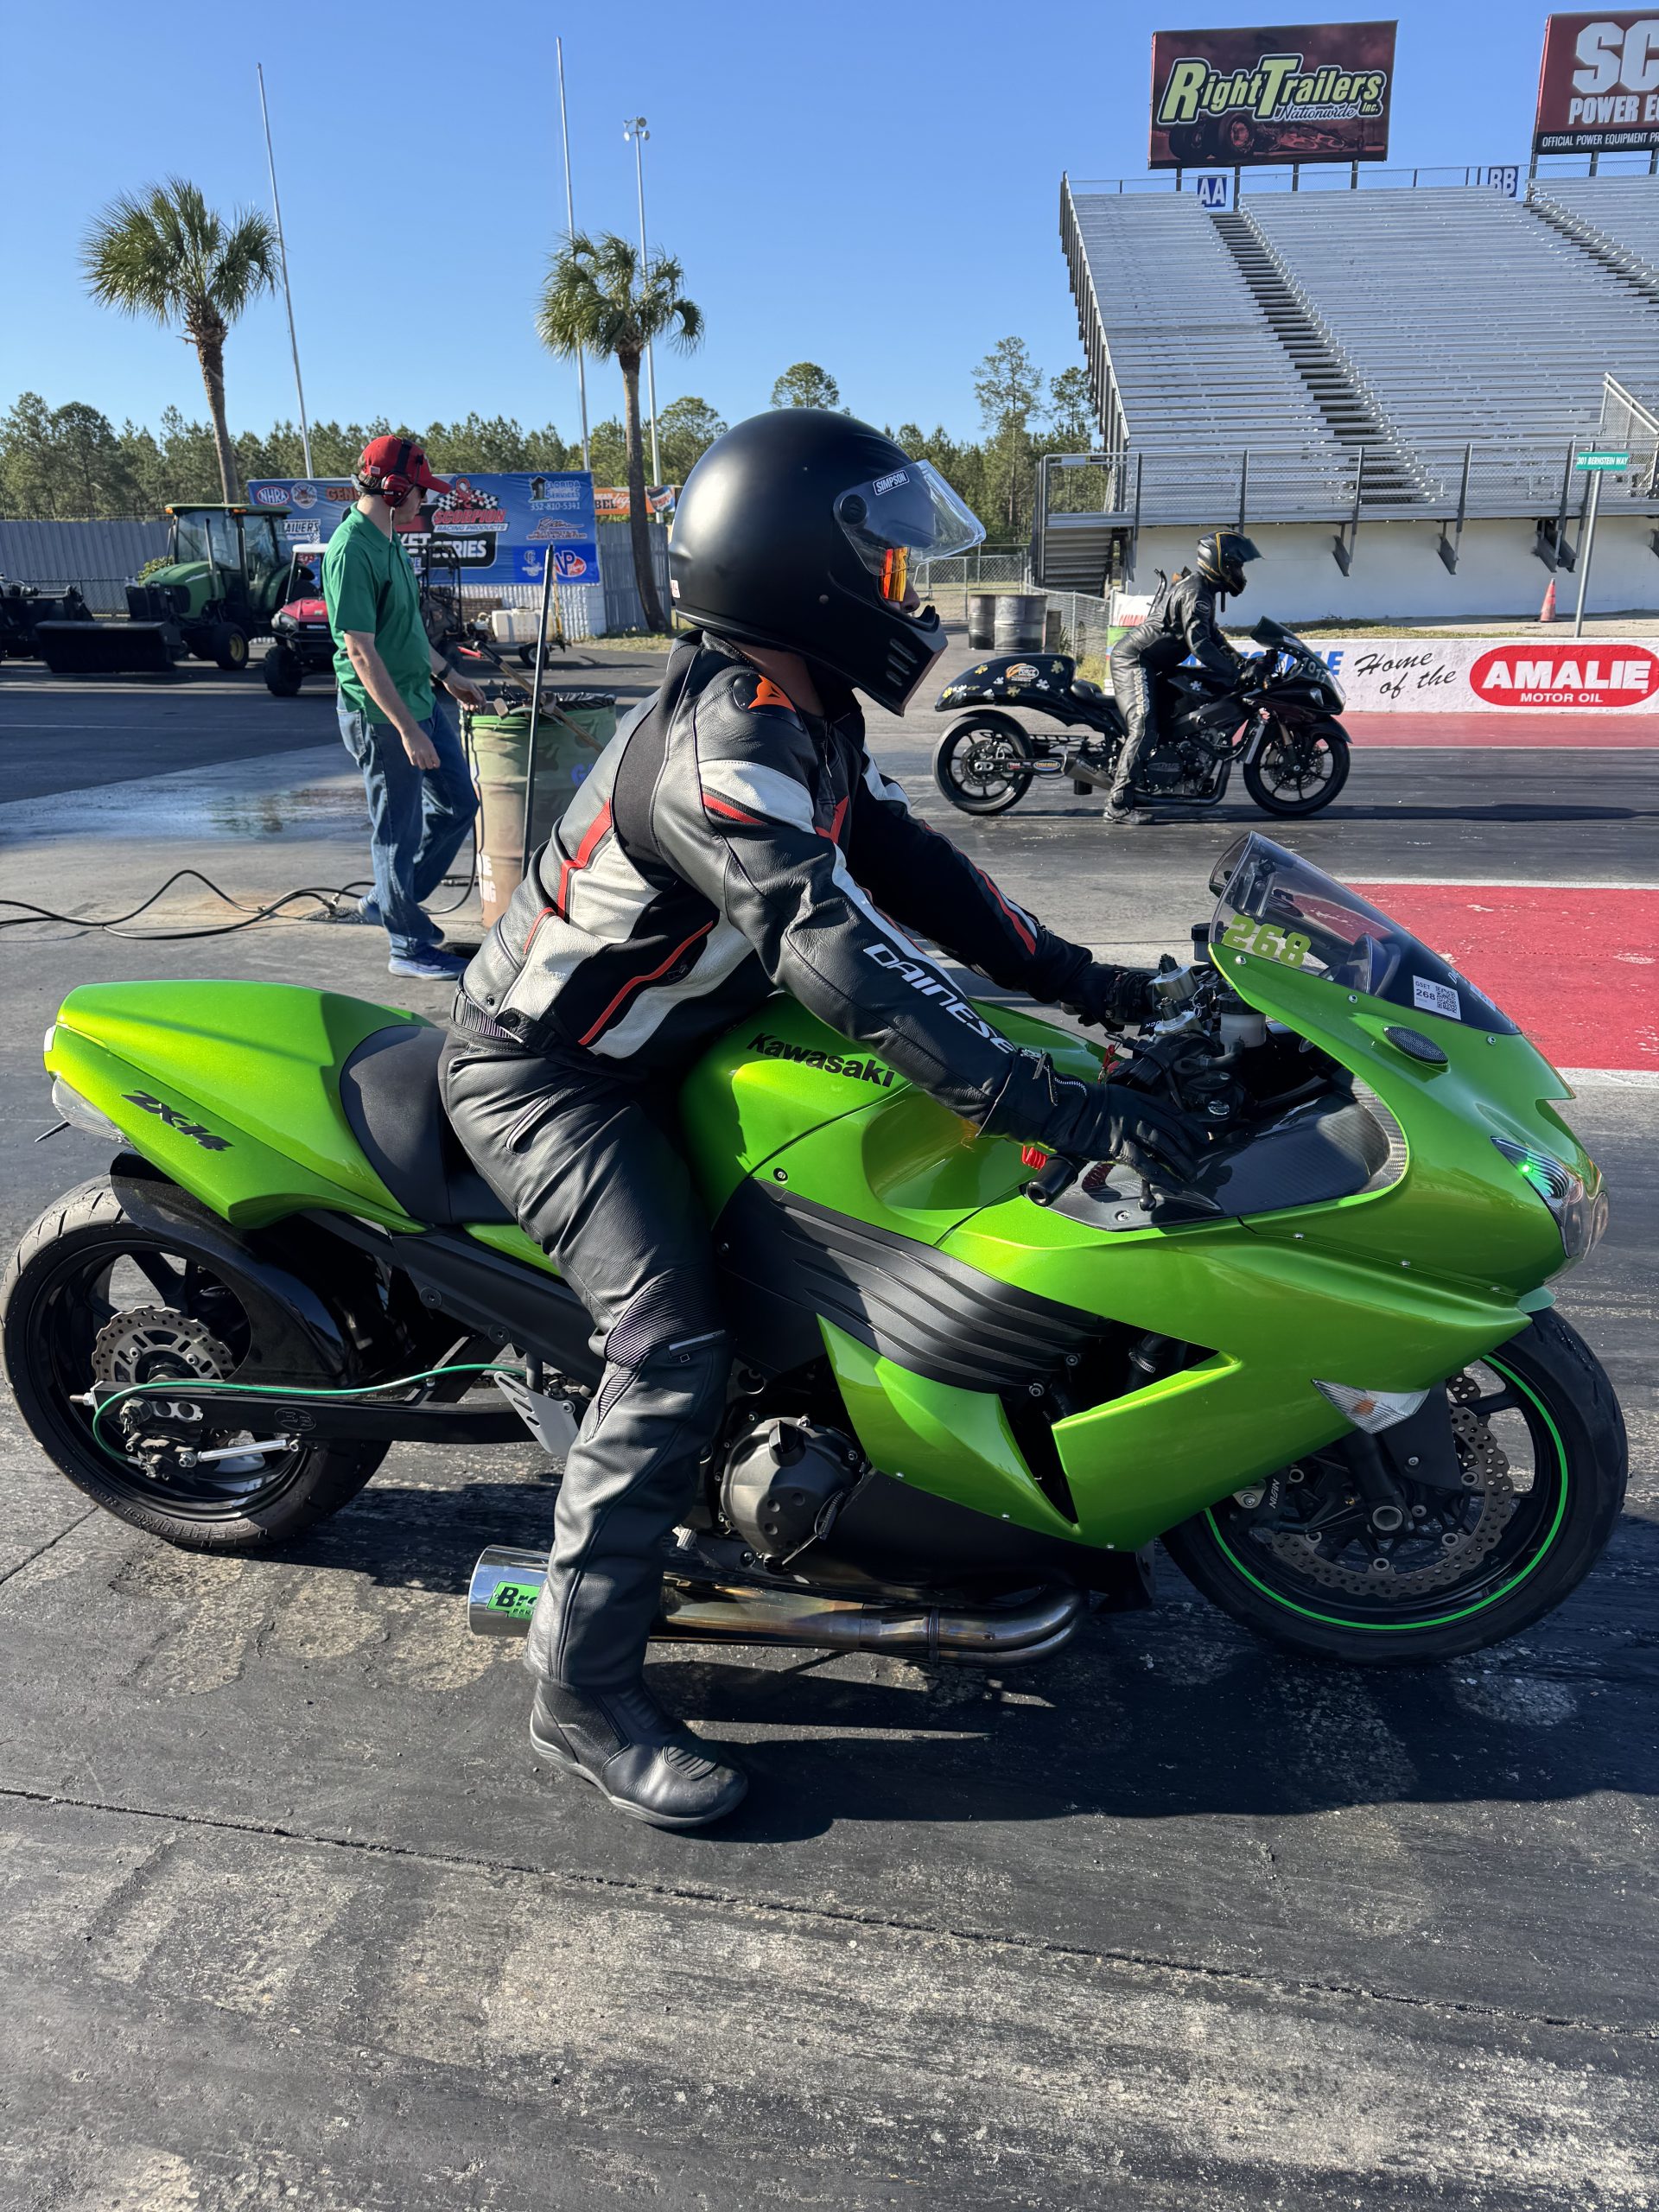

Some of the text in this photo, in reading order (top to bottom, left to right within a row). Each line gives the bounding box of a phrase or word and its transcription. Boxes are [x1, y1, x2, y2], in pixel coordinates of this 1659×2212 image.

[1278, 100, 1379, 121] Nationwide Inc.
[1568, 93, 1659, 124] POWER E
[1542, 135, 1573, 147] OFFICIAL
[1576, 134, 1603, 146] POWER
[1605, 132, 1648, 145] EQUIPMENT
[1198, 178, 1225, 205] AA
[1490, 168, 1517, 194] BB
[1577, 456, 1629, 465] 301 BERNSTEIN WAY
[875, 472, 907, 493] SIMPSON
[258, 488, 289, 504] NHRA
[594, 499, 618, 509] BEL
[433, 508, 507, 524] SCORPION
[285, 522, 321, 534] AILERS
[466, 523, 505, 531] PRODUCTS
[556, 551, 576, 575] VP
[1354, 652, 1434, 677] Home
[1481, 660, 1652, 690] AMALIE
[1379, 664, 1458, 699] of the
[1520, 692, 1604, 702] MOTOR OIL
[1221, 914, 1312, 968] 268
[863, 943, 1019, 1054] DAINESE
[1416, 988, 1436, 1001] 268
[746, 1033, 896, 1089] Kawasaki
